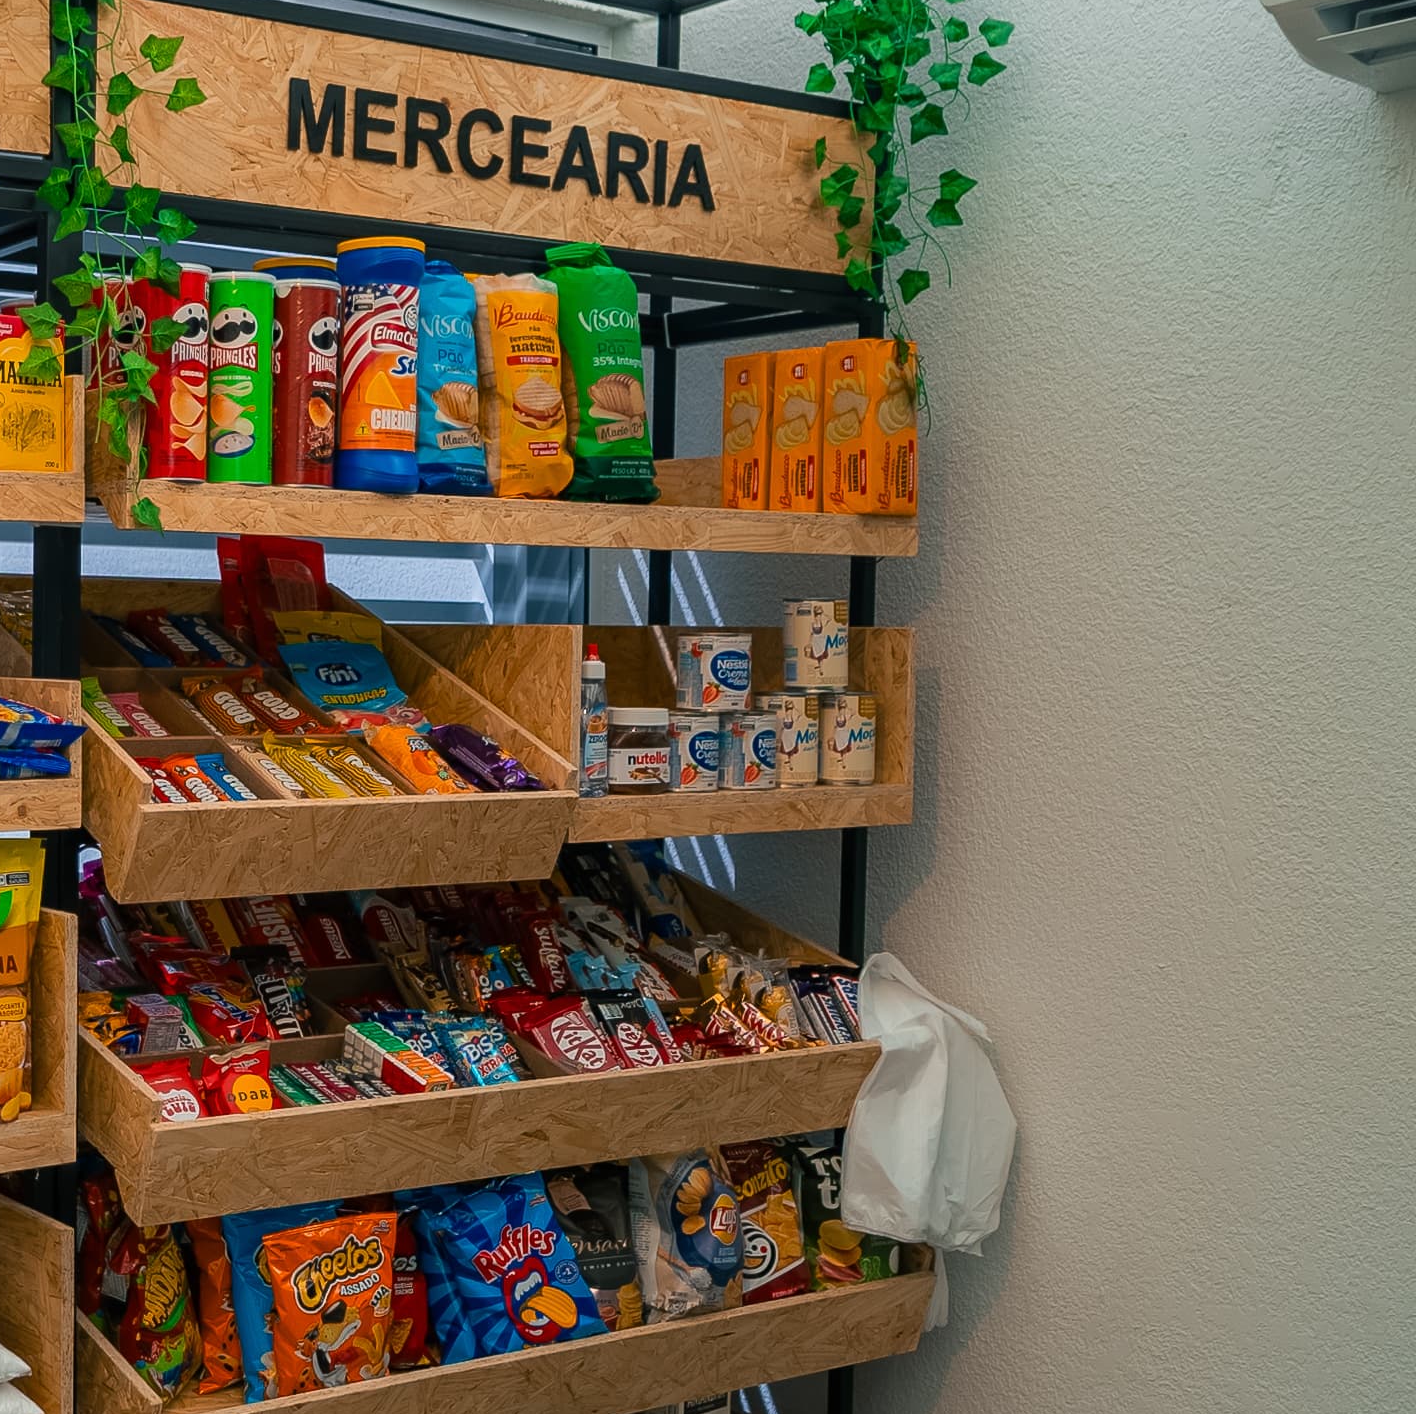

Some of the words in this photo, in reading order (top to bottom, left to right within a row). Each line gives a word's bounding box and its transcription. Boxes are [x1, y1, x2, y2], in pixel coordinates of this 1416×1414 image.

[287, 77, 716, 213] MERCEARIA
[210, 346, 257, 368] PRINGLES
[438, 349, 464, 364] Pão
[511, 343, 555, 354] natural
[593, 356, 615, 366] 35%
[317, 663, 361, 685] Fini
[252, 689, 301, 721] BOLD
[628, 753, 668, 766] nutella
[553, 1024, 604, 1067] KitKat
[472, 1222, 558, 1285] Ruffles
[292, 1234, 383, 1313] Cheetos
[339, 1274, 380, 1296] ASSADO
